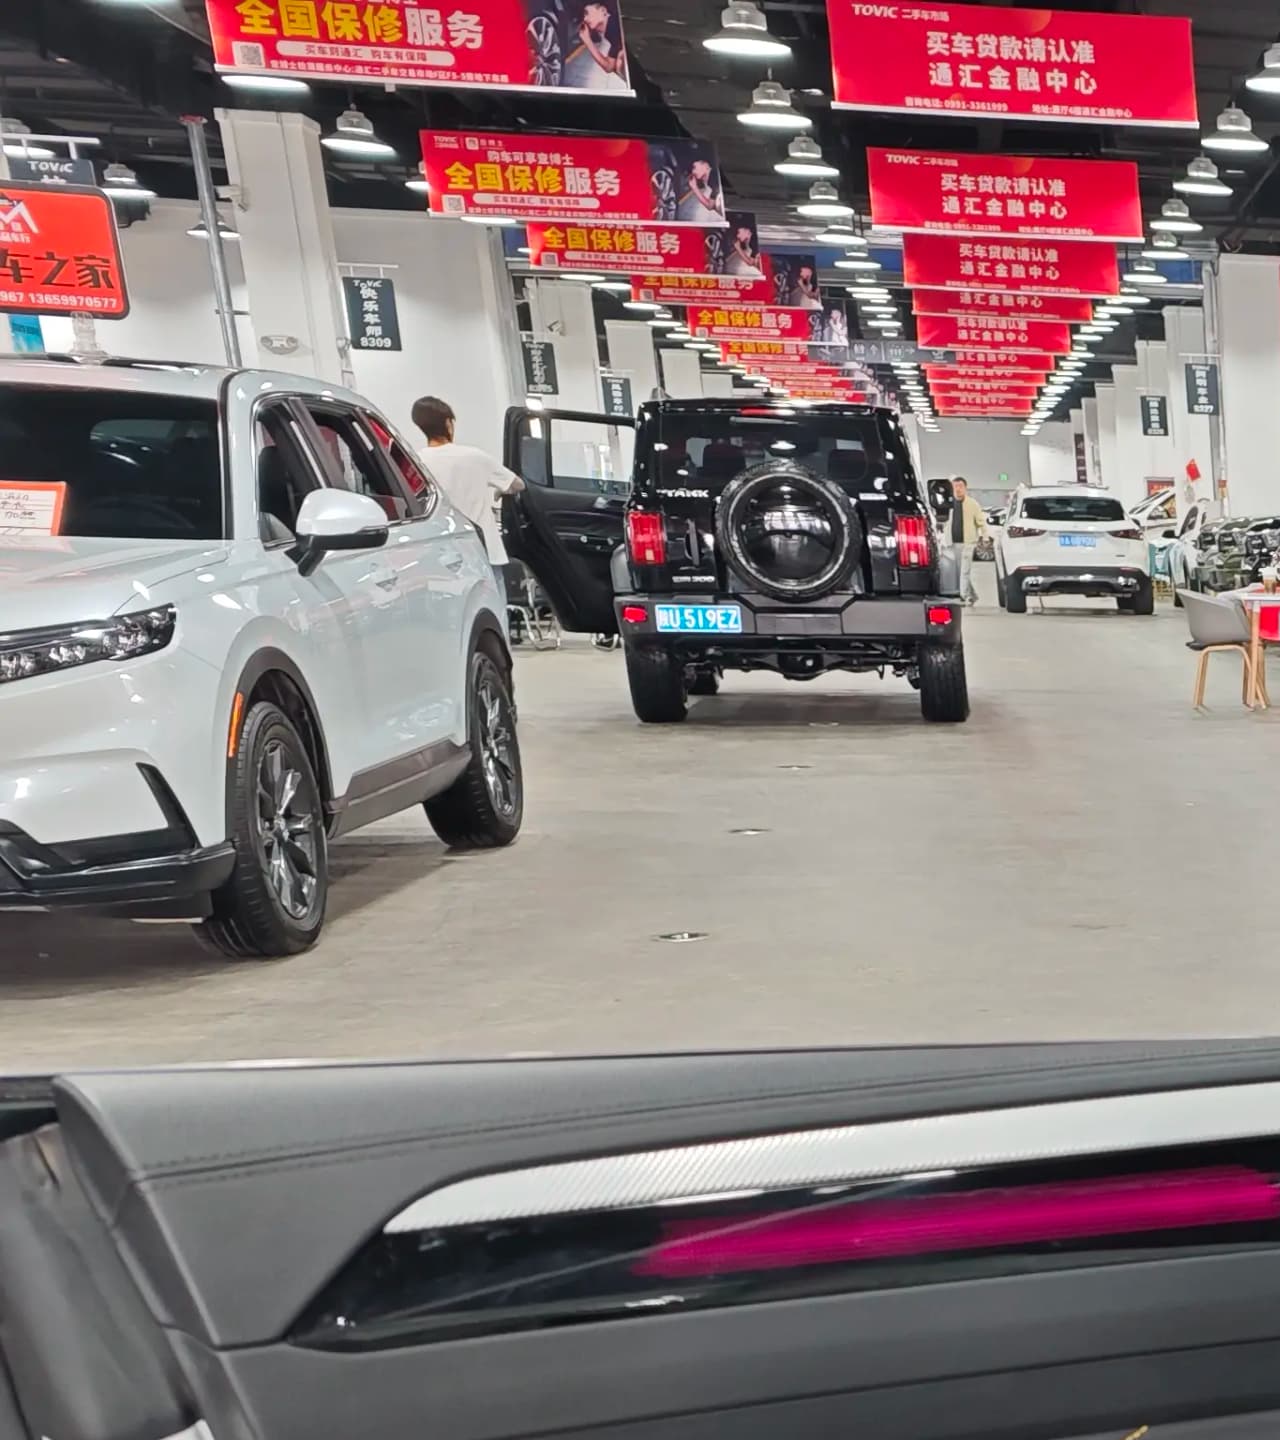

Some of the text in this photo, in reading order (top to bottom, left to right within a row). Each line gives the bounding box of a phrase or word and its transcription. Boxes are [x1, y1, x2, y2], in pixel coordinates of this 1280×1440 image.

[851, 3, 898, 19] TOVIC
[235, 0, 484, 49] 全国保修服务
[926, 31, 1095, 65] 买车贷款请认准
[929, 63, 1098, 95] 通汇金融中心
[28, 160, 73, 173] TOVIC
[886, 154, 920, 165] TOVIC
[444, 161, 621, 197] 全国保修服务
[941, 173, 1066, 197] 买车贷款请认准
[942, 196, 1067, 219] 通汇金融中心
[543, 226, 680, 254] 全国保修服务
[959, 243, 1058, 263] 买车贷款请认准
[960, 261, 1060, 280] 通汇金融中心
[360, 336, 392, 347] 8309
